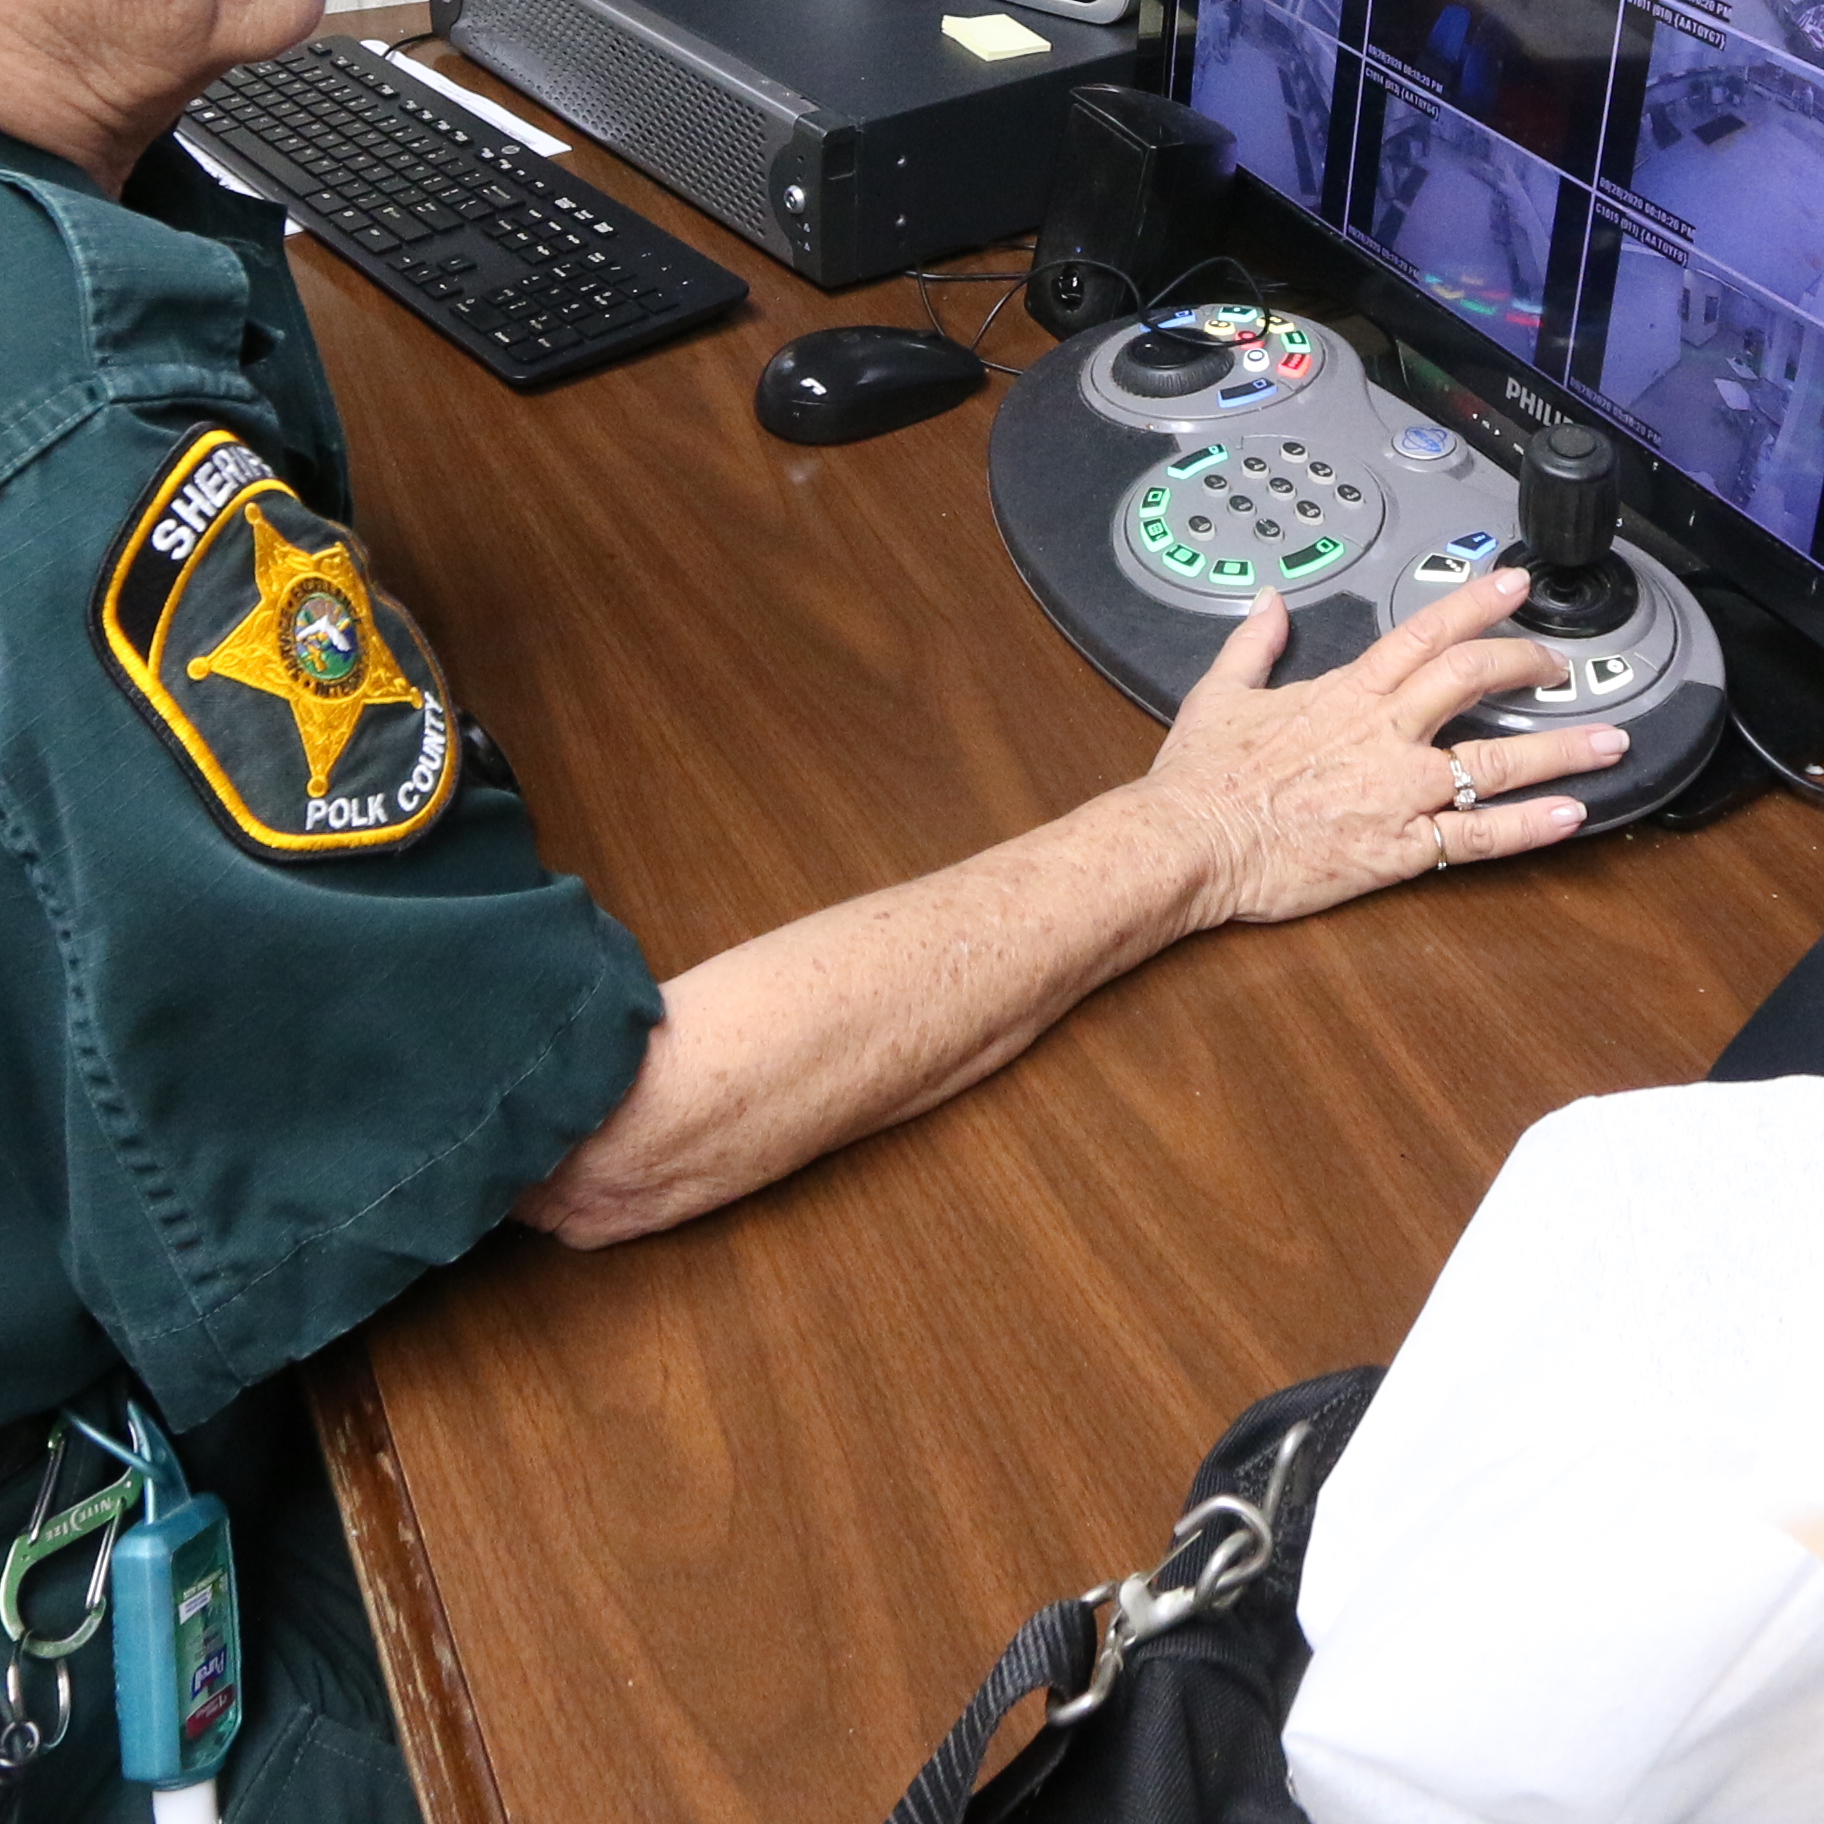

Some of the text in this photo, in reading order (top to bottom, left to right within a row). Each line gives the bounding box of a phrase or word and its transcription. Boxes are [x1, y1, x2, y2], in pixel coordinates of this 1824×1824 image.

[1716, 2, 1733, 18] PM
[1505, 376, 1574, 427] PHILI
[305, 691, 445, 831] POLK COUNTY
[44, 1496, 114, 1542] NITE IZE
[194, 1650, 226, 1691] Purell
